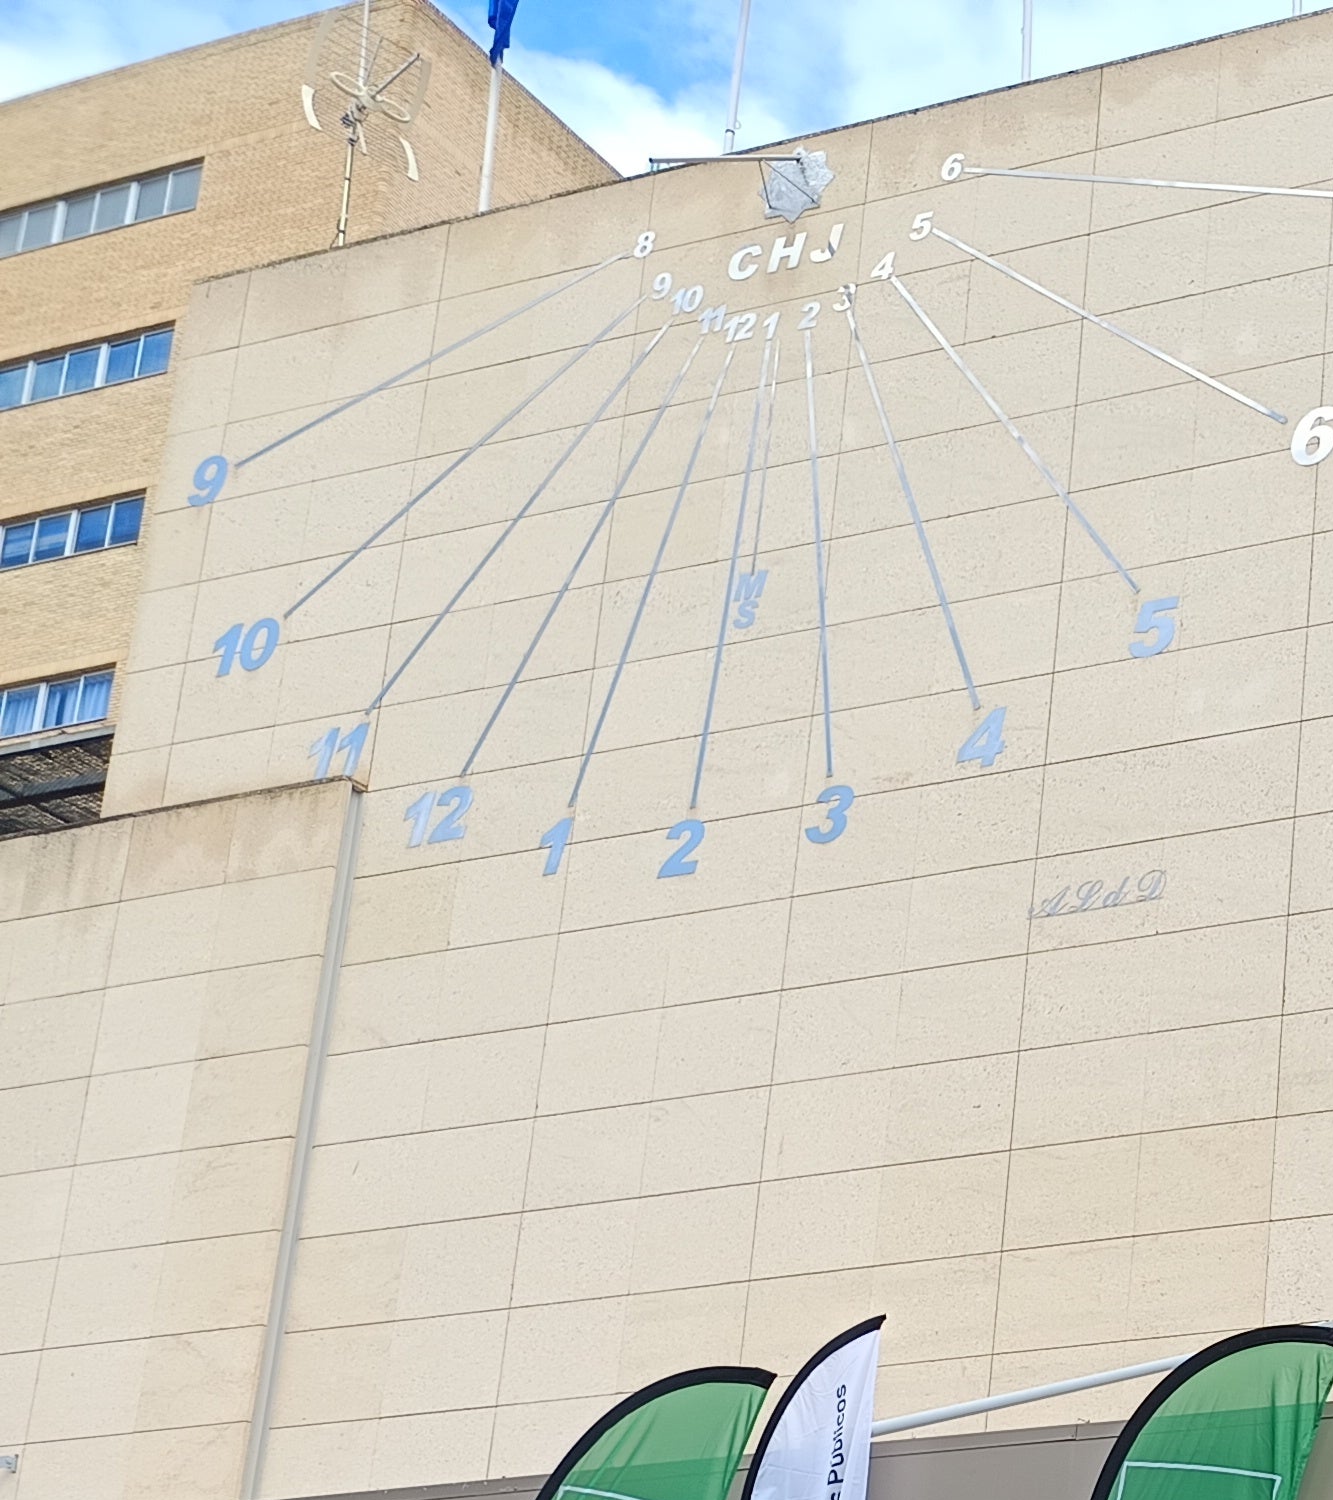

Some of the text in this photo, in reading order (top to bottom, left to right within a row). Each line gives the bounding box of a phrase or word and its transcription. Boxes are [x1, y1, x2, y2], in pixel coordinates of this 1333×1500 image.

[940, 154, 965, 180] 6
[909, 213, 934, 240] 5
[633, 232, 655, 256] 8
[727, 223, 844, 280] CHJ
[870, 252, 896, 280] 4
[652, 273, 673, 300] 9
[672, 286, 704, 313] 10
[834, 284, 855, 311] 3
[701, 305, 725, 333] 11
[725, 314, 755, 342] 12
[764, 314, 779, 340] 1
[799, 303, 820, 329] 2
[186, 455, 228, 506] 9
[1127, 596, 1179, 657] 5
[212, 616, 279, 676] 10
[307, 721, 370, 779] 11
[956, 706, 1006, 766] 4
[404, 785, 474, 848] 12
[805, 784, 855, 843] 3
[539, 817, 573, 875] 1
[656, 819, 705, 879] 2
